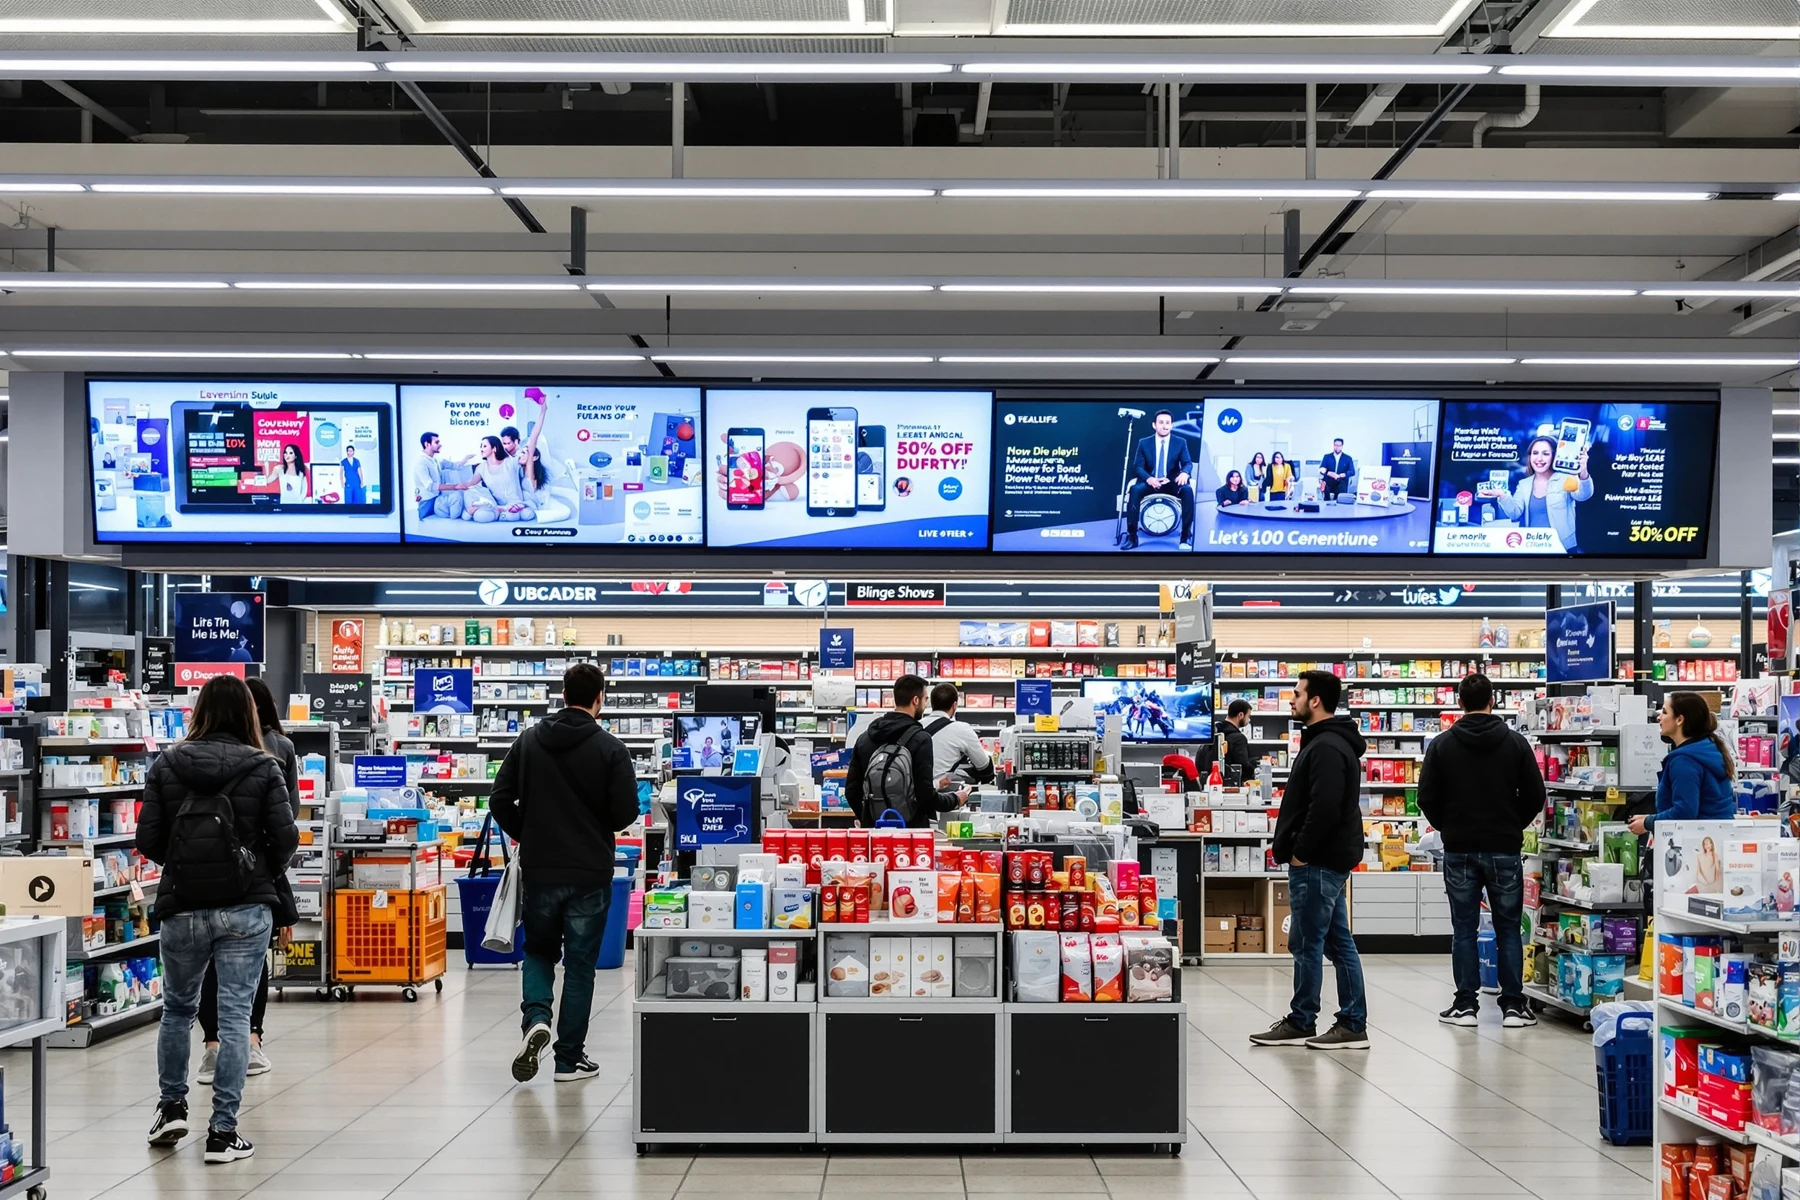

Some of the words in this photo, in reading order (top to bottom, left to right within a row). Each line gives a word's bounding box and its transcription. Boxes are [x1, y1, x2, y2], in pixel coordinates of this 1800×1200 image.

[897, 441, 937, 455] 50%
[941, 442, 974, 455] OFF
[857, 585, 896, 601] Blinge
[210, 629, 218, 639] is
[220, 629, 239, 639] Me!
